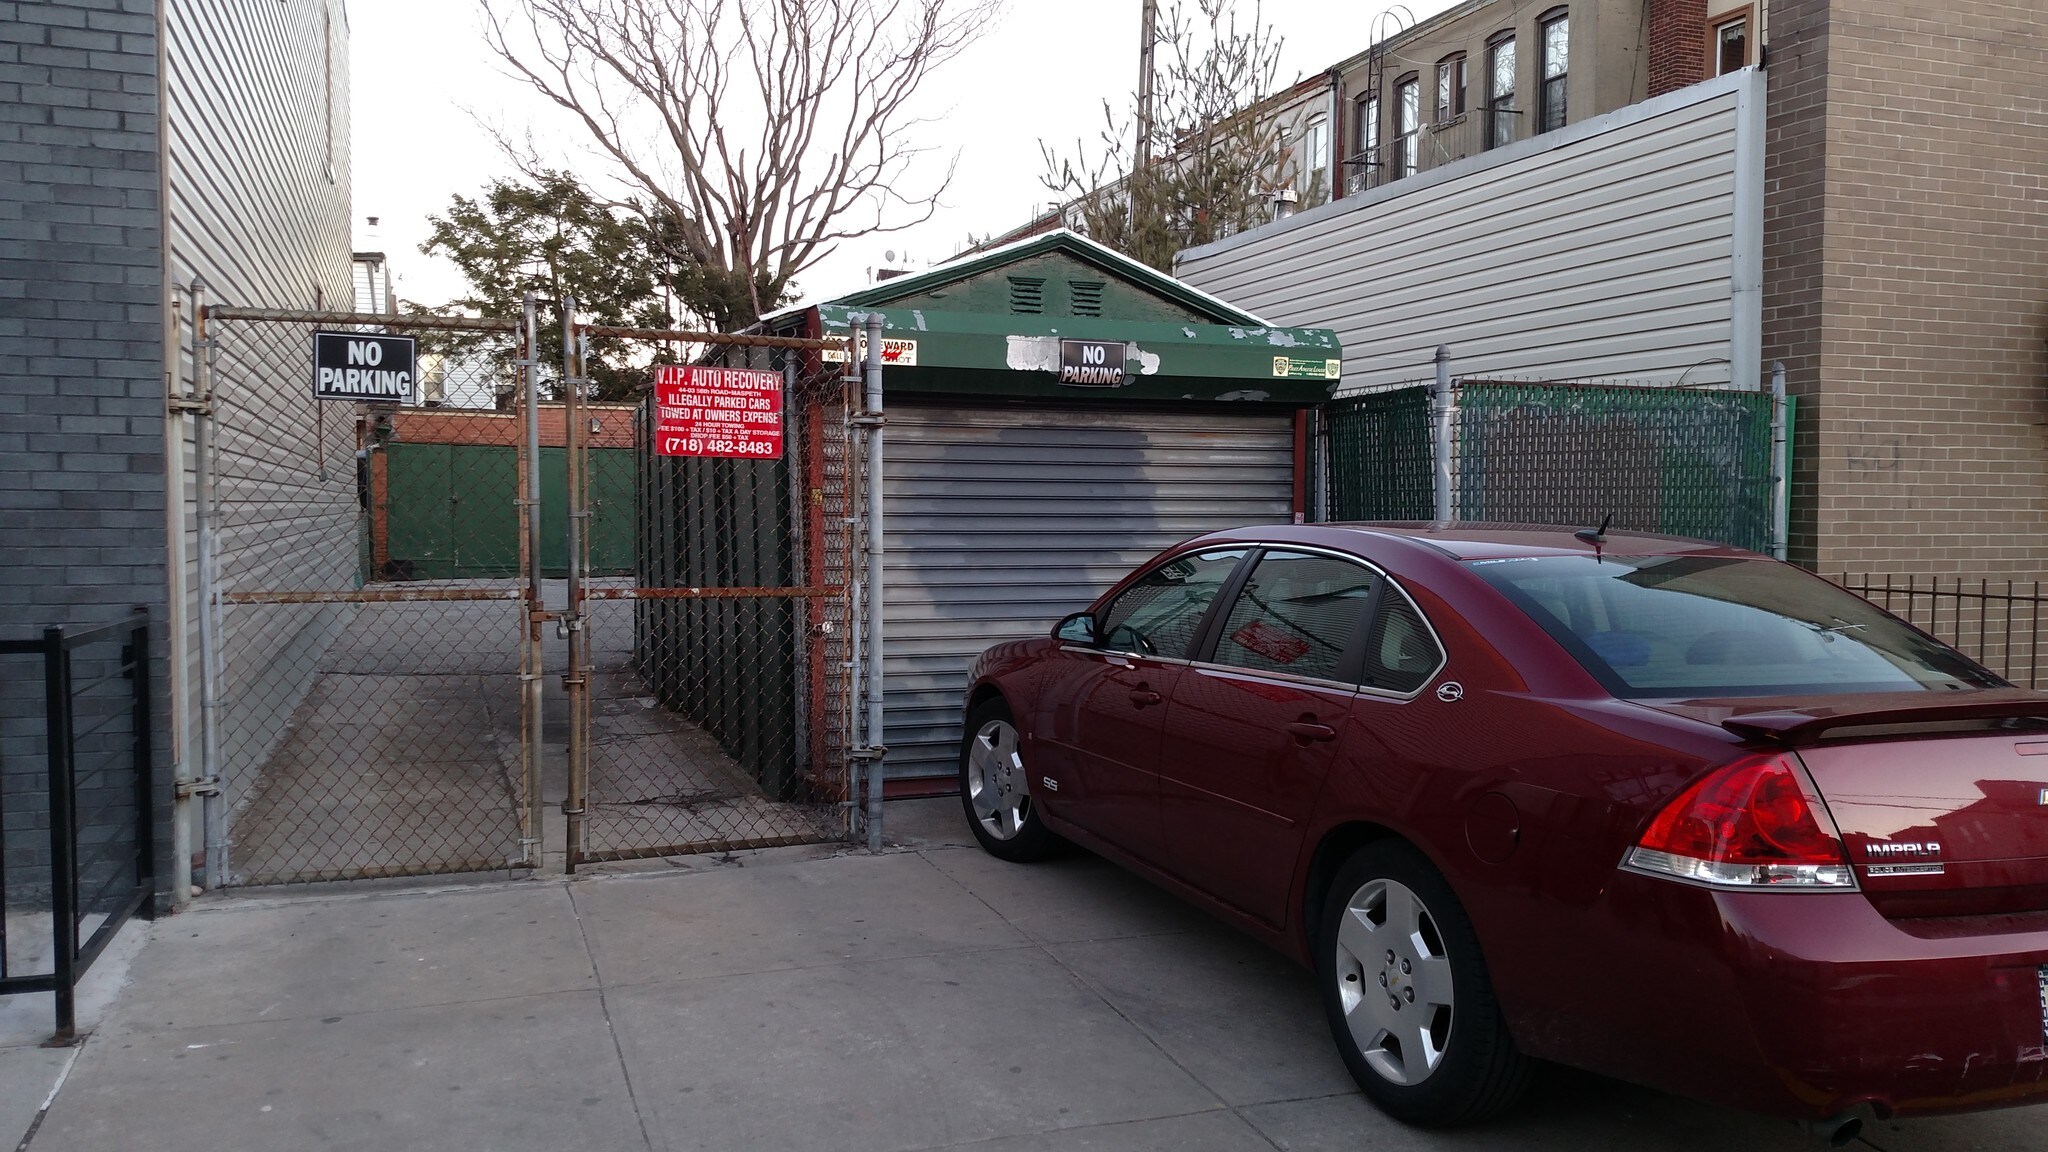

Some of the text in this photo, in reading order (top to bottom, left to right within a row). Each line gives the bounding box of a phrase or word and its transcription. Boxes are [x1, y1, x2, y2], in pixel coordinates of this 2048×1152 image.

[348, 340, 382, 366] NO
[881, 340, 914, 351] WARD
[1082, 345, 1105, 365] NO
[319, 367, 411, 396] PARKING
[658, 366, 780, 391] V.I.P. AUTO RECOVERY
[1061, 365, 1123, 385] PARKING
[668, 393, 771, 410] ILLEGALLY PARKED CARS
[660, 406, 778, 424] TOWED AT OWNERS EXPENSE
[665, 437, 773, 454] (718) 482-8483
[1043, 776, 1058, 792] SS
[1866, 842, 1941, 857] IMPALA
